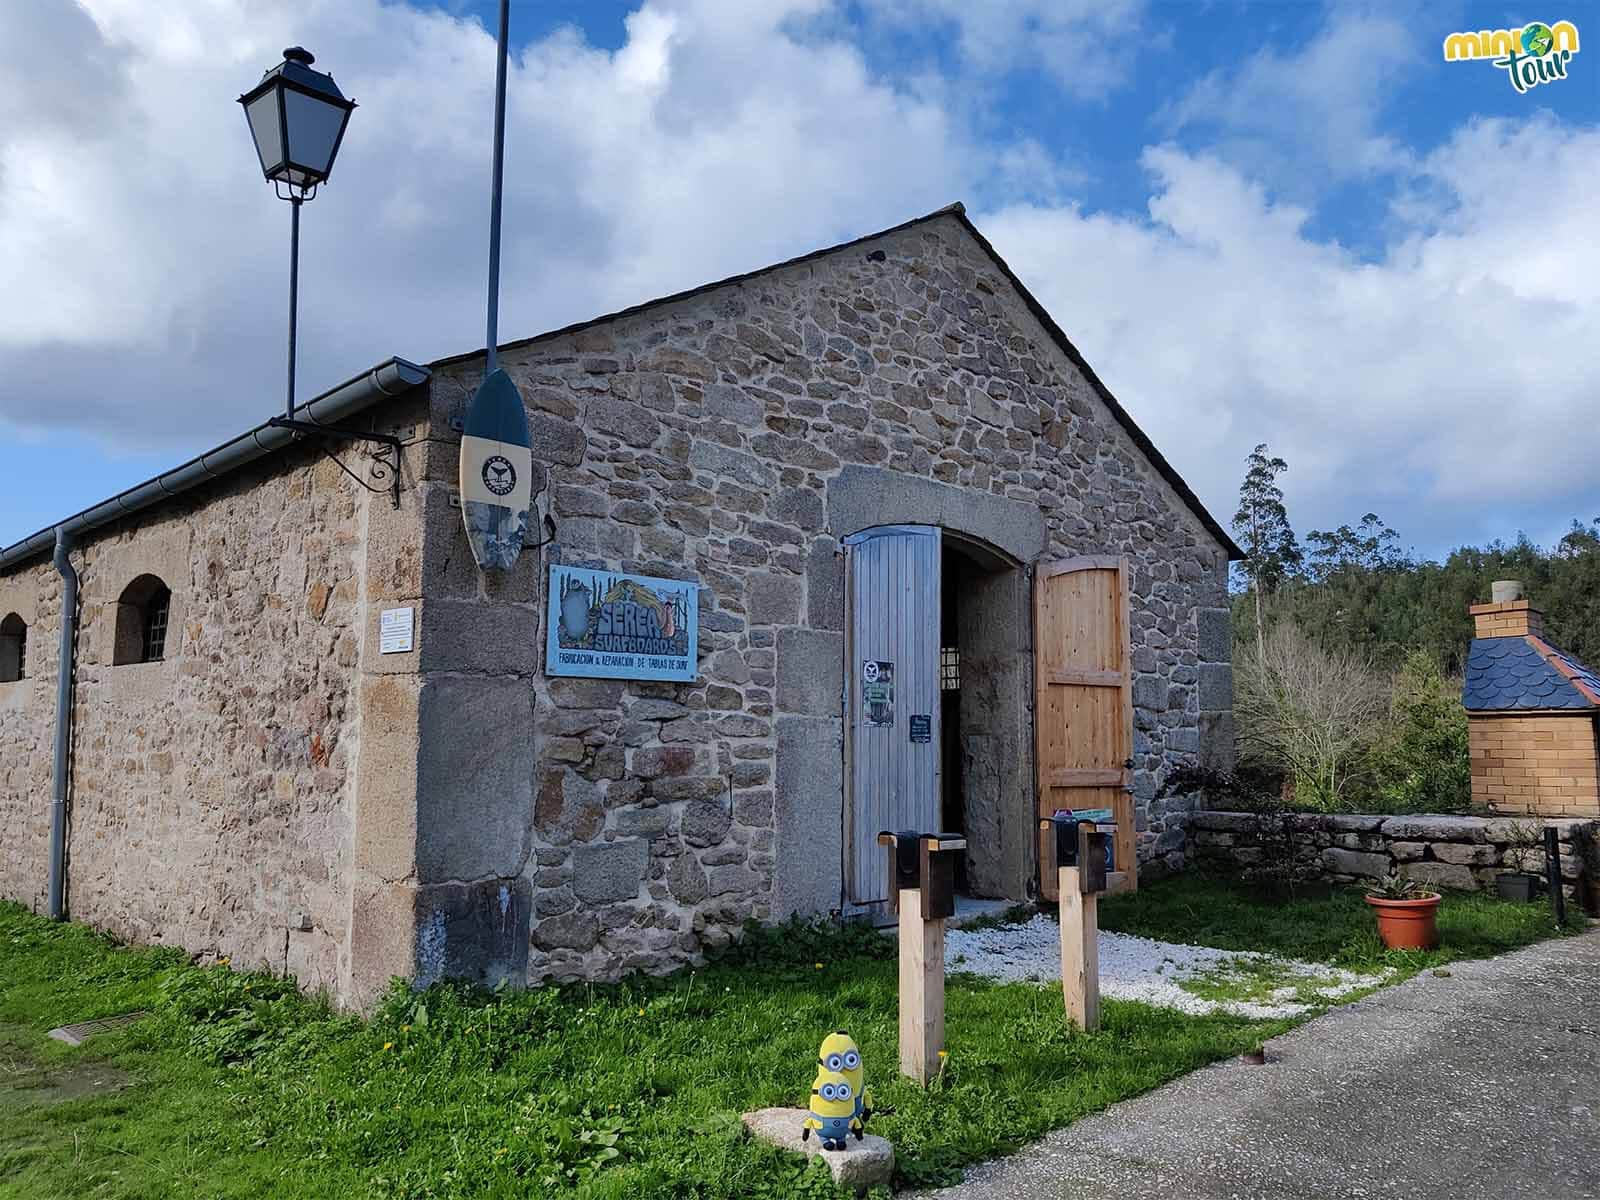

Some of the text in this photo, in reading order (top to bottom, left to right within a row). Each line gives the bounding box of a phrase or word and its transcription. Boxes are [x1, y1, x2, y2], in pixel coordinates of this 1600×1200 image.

[598, 601, 658, 638] SEREA
[594, 634, 677, 656] SURFBOARDS
[637, 657, 645, 668] DE
[668, 659, 675, 669] DE
